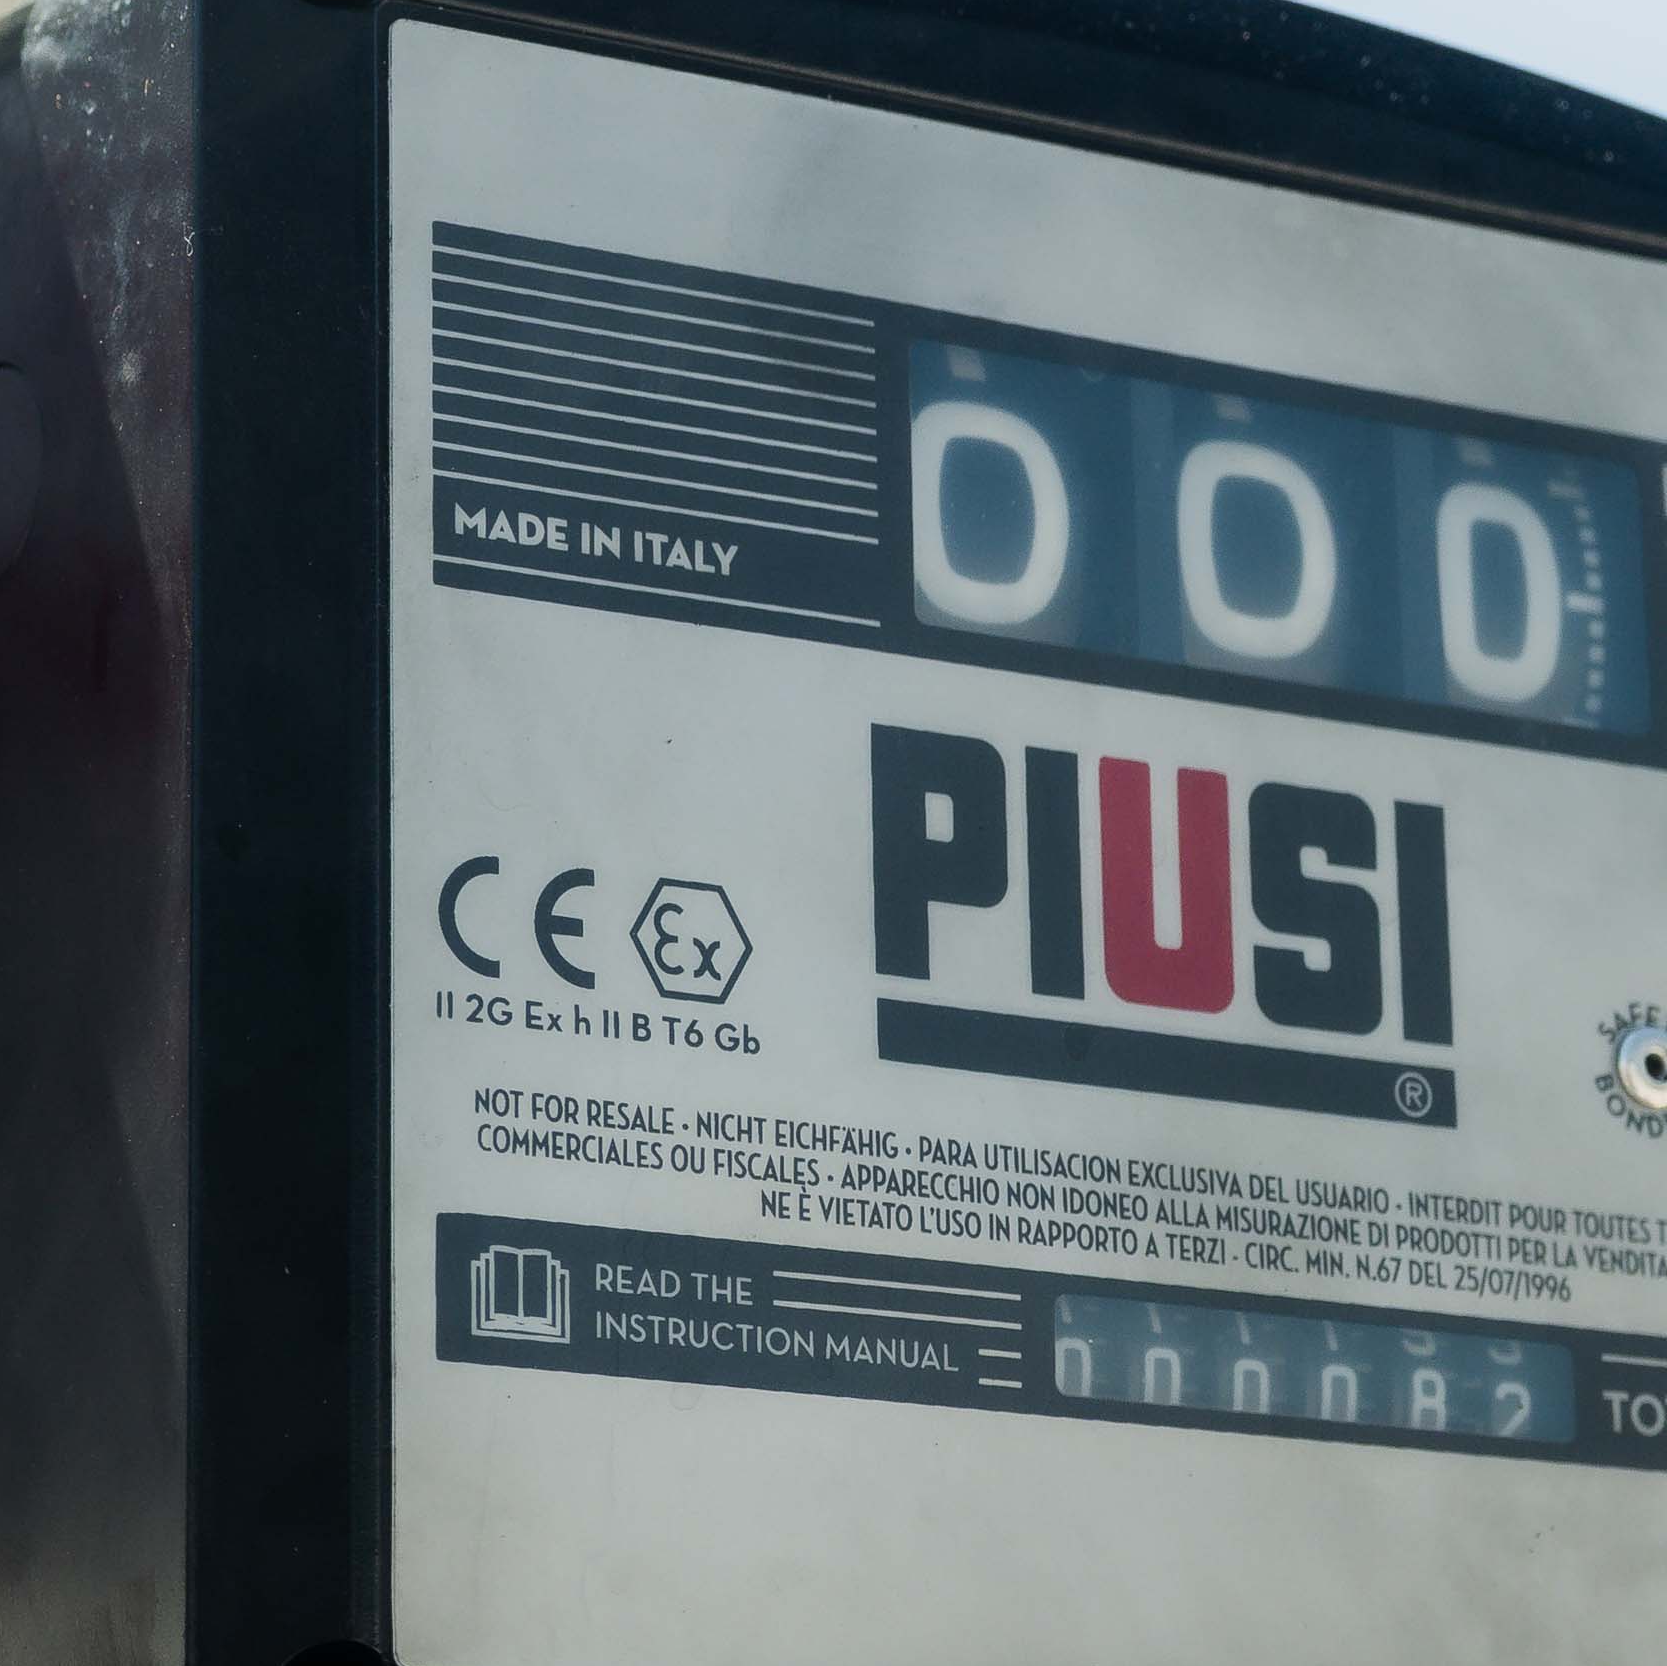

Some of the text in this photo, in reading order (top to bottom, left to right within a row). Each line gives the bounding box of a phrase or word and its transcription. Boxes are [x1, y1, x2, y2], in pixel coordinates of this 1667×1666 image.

[455, 502, 739, 576] MADE IN ITALY
[869, 721, 1455, 1046] PIUSI
[466, 993, 513, 1026] 2G
[525, 1000, 563, 1033] Ex
[574, 1004, 591, 1035] h
[632, 1012, 652, 1043] B
[662, 1016, 704, 1049] T6
[714, 1023, 761, 1056] Gb
[474, 1088, 524, 1118] NOT
[531, 1092, 579, 1126] FOR
[586, 1098, 675, 1135] RESALE
[696, 1110, 767, 1145] NICHT
[775, 1118, 899, 1159] EICHFÄHIG
[919, 1135, 978, 1169] PARA
[984, 1143, 1122, 1184] UTILISACION
[1128, 1159, 1244, 1199] EXCLUSIVA
[1249, 1173, 1290, 1204] DEL
[1296, 1178, 1389, 1215] USUARIO
[1408, 1191, 1503, 1226] INTERDIT
[1509, 1201, 1568, 1235] POUR
[1574, 1209, 1652, 1245] TOUTES
[477, 1123, 664, 1170] COMMERCIALES
[670, 1144, 706, 1175] OU
[713, 1148, 820, 1187] FISCALES
[840, 1163, 1000, 1206] APPARECCHIO
[1007, 1181, 1056, 1212] NON
[1063, 1187, 1148, 1222] IDONEO
[1155, 1198, 1210, 1230] ALLA
[1217, 1204, 1361, 1247] MISURAZIONE
[1369, 1221, 1389, 1249] DI
[1396, 1225, 1502, 1262] PRODOTTI
[1508, 1237, 1547, 1266] PER
[1553, 1242, 1578, 1269] LA
[595, 1262, 754, 1307] READ THE
[761, 1190, 791, 1220] NE
[798, 1186, 812, 1222] È
[818, 1195, 913, 1231] VIETATO
[989, 1213, 1011, 1242] IN
[1018, 1217, 1139, 1255] RAPPORTO
[1145, 1231, 1160, 1258] A
[1165, 1233, 1226, 1265] TERZI
[1245, 1242, 1299, 1274] CIRC.
[1306, 1249, 1350, 1279] MIN.
[1356, 1254, 1402, 1283] N.67
[1409, 1260, 1447, 1289] DEL
[1454, 1265, 1572, 1303] 25/07/1996
[595, 1310, 960, 1373] INSTRUCTION MANUAL
